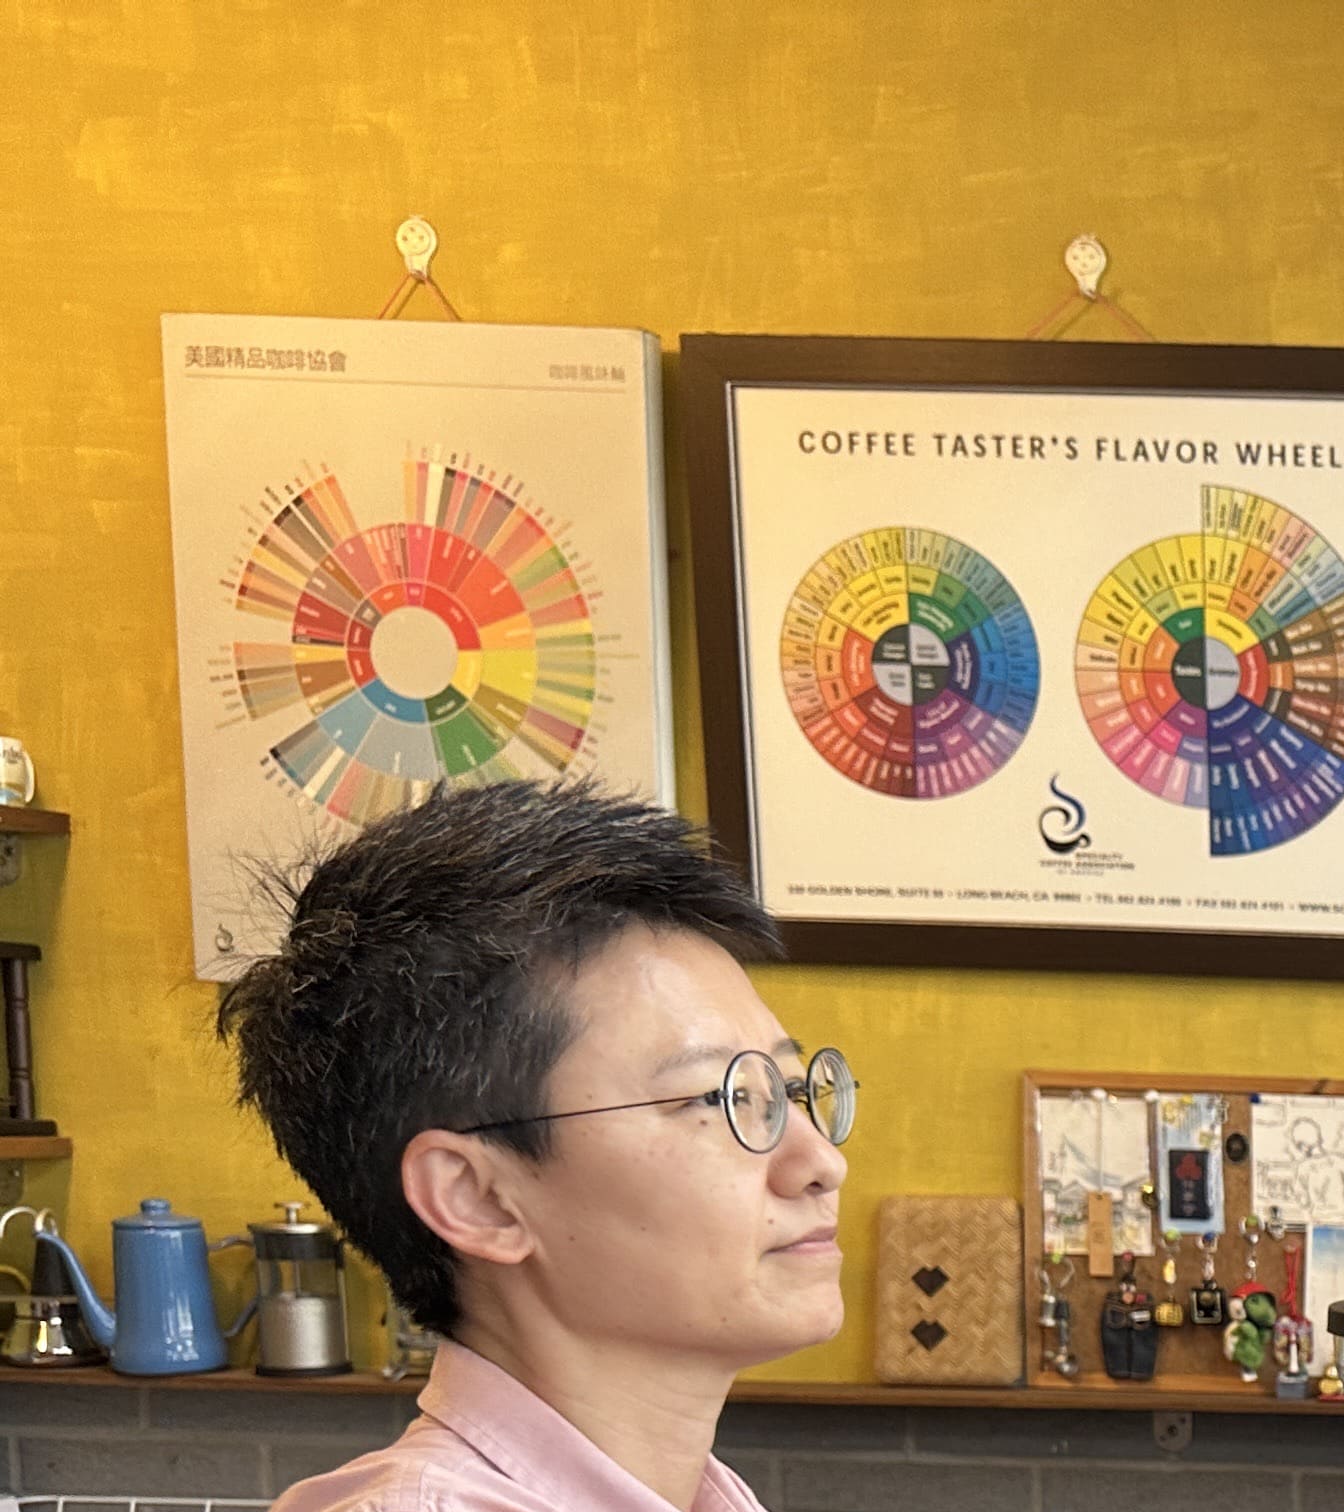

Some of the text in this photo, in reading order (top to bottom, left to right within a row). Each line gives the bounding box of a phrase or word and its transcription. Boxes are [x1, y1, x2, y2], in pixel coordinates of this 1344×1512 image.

[184, 344, 348, 373] 美國精品咖啡協會
[797, 430, 1344, 469] COFFEE TASTER'S FLAVOR WHEEL
